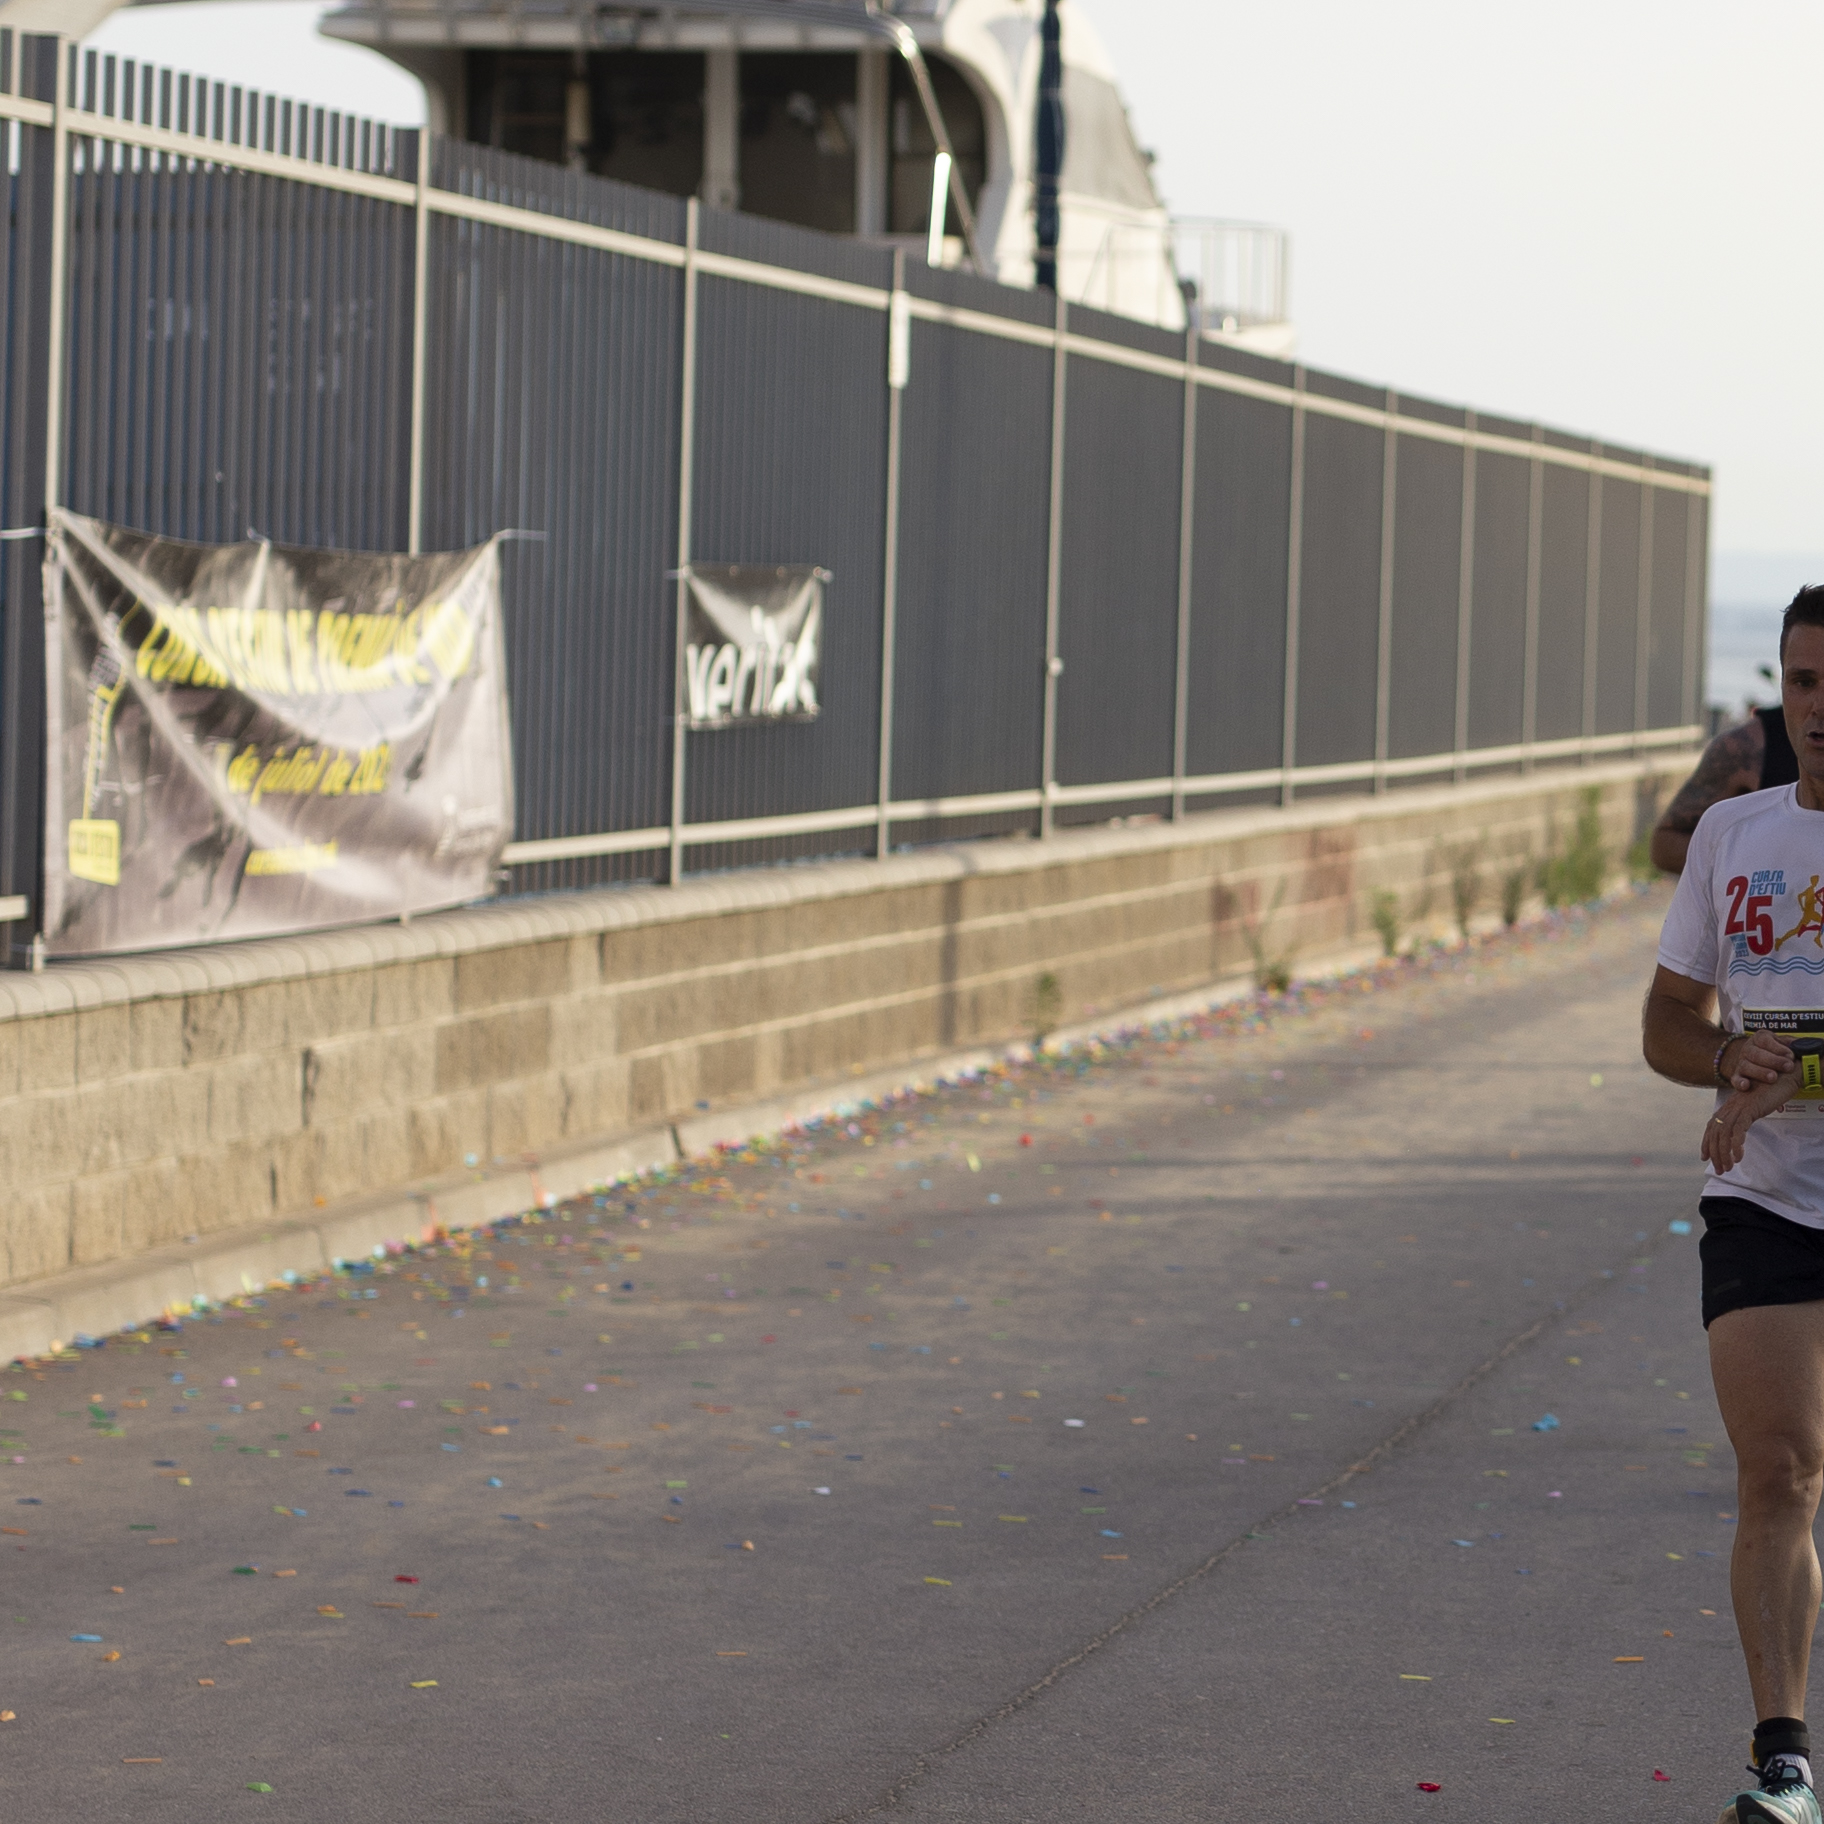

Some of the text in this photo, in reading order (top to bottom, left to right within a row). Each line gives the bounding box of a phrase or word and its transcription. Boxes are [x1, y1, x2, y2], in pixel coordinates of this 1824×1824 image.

[1752, 870, 1784, 883] CURSA
[1749, 882, 1786, 896] D'ESTIU
[1725, 876, 1773, 956] 25
[1764, 1012, 1790, 1021] CURSA
[1791, 1012, 1824, 1021] D'ESTIU
[1768, 1021, 1779, 1030] DE
[1780, 1022, 1798, 1030] MAR
